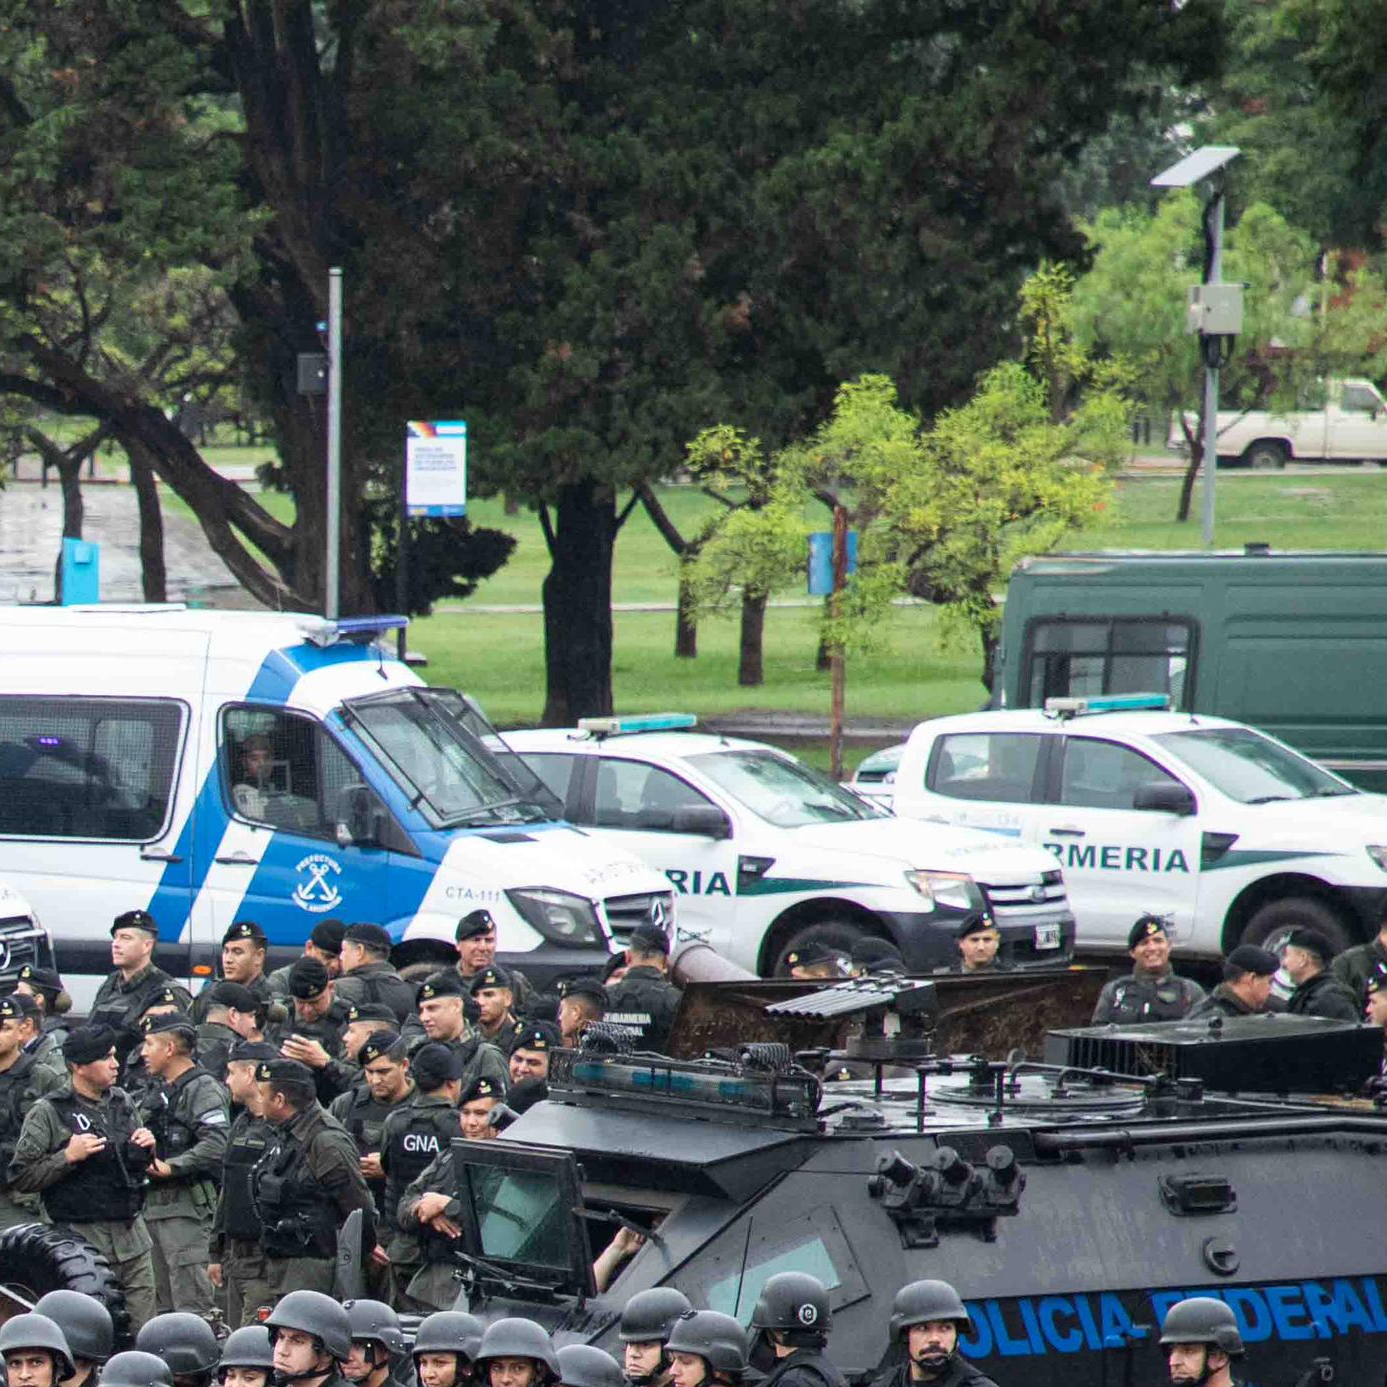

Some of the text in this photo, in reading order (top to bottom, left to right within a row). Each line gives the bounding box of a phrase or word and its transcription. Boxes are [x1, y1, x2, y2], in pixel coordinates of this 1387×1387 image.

[403, 1133, 440, 1153] GNA
[957, 1275, 1387, 1361] OLICIA FDERAL
